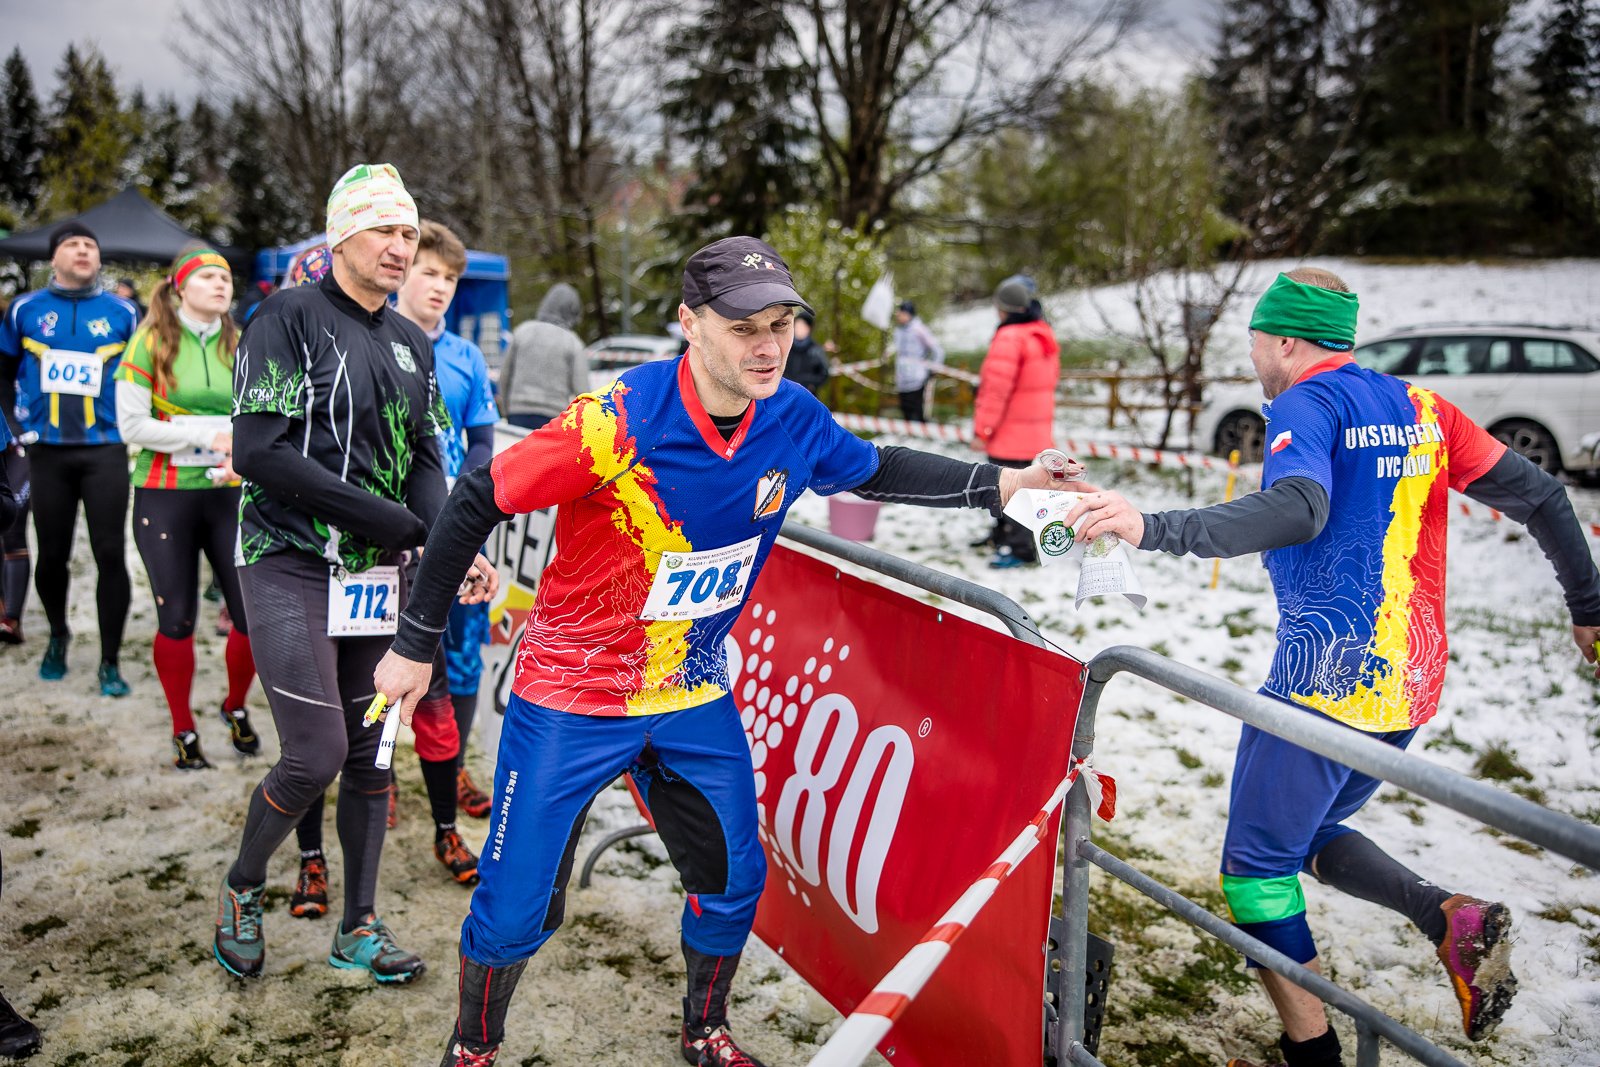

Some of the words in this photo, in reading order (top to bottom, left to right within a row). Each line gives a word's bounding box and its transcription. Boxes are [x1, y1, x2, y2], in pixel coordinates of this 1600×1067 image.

[48, 363, 90, 384] 605
[1345, 424, 1380, 449] UKS
[667, 559, 742, 606] 708
[344, 584, 389, 619] 712
[505, 770, 518, 795] UKS
